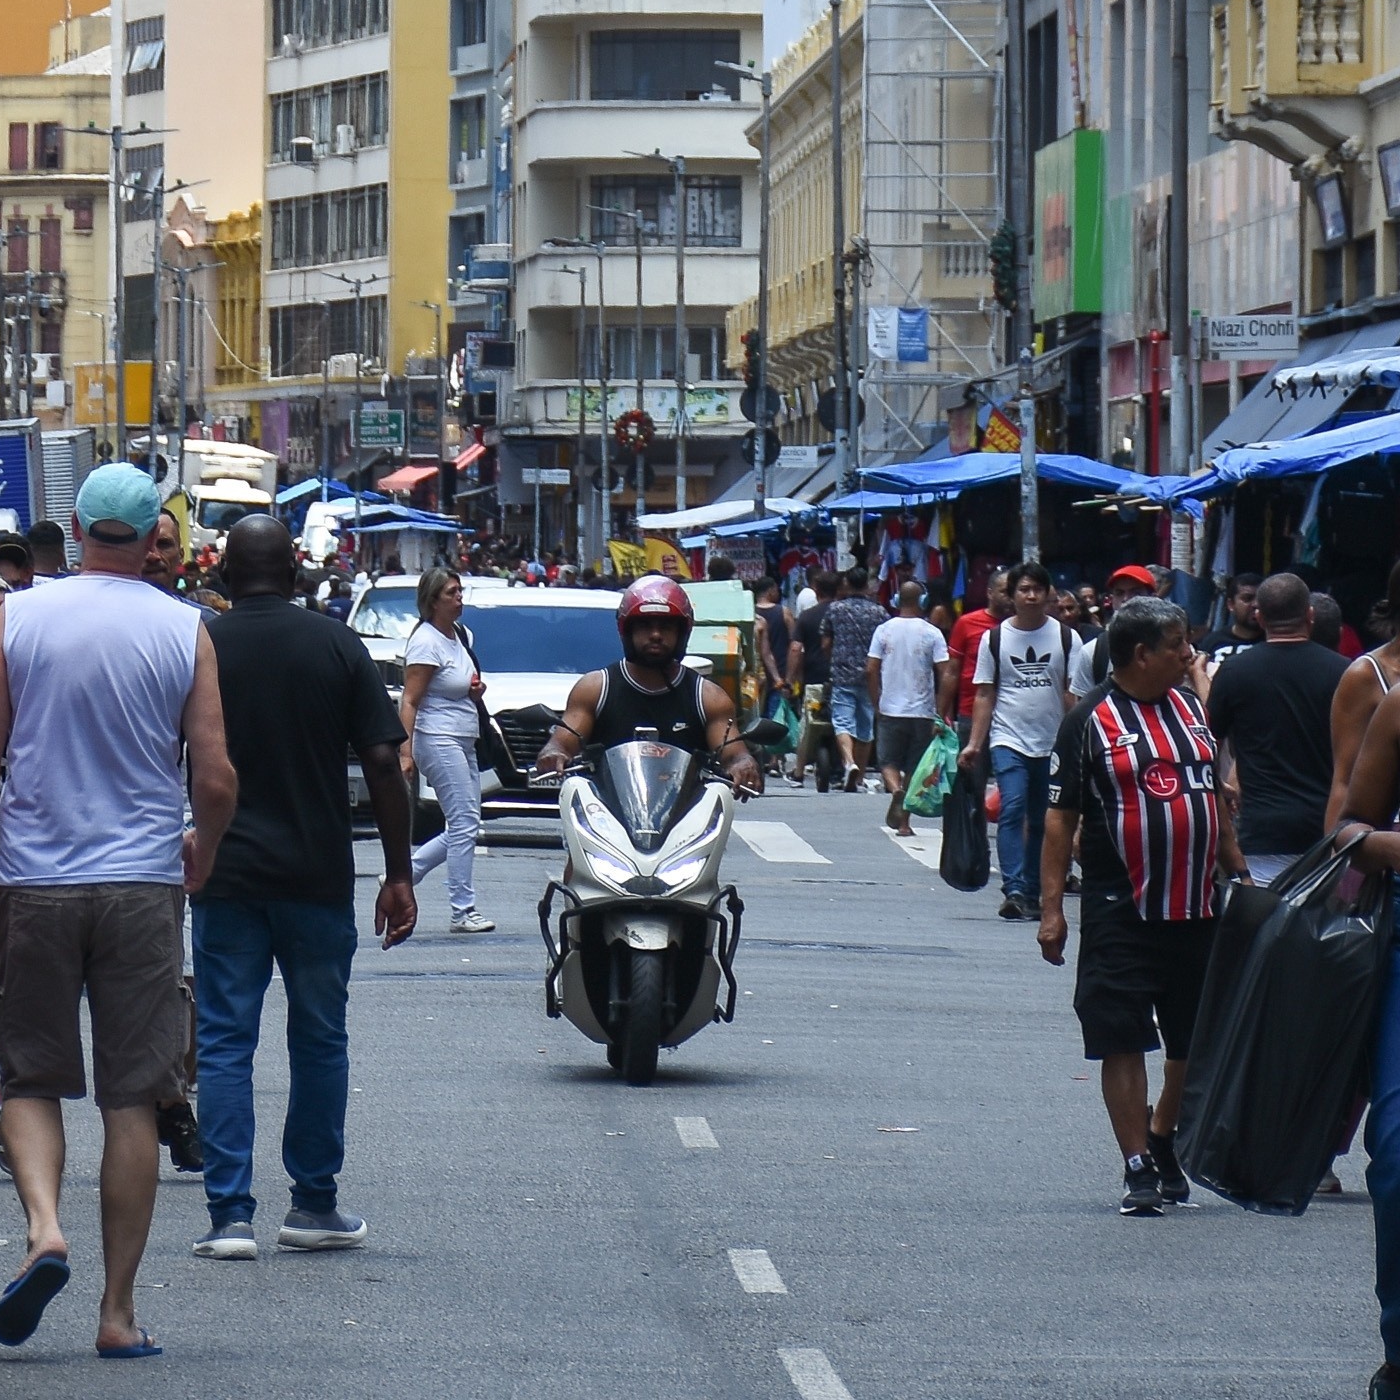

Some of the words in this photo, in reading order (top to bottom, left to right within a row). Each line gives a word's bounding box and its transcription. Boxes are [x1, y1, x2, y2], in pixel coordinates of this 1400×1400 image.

[1211, 321, 1245, 337] Niazi
[1249, 320, 1294, 336] Chohfi
[1015, 677, 1052, 688] adidas
[1186, 765, 1214, 790] LG
